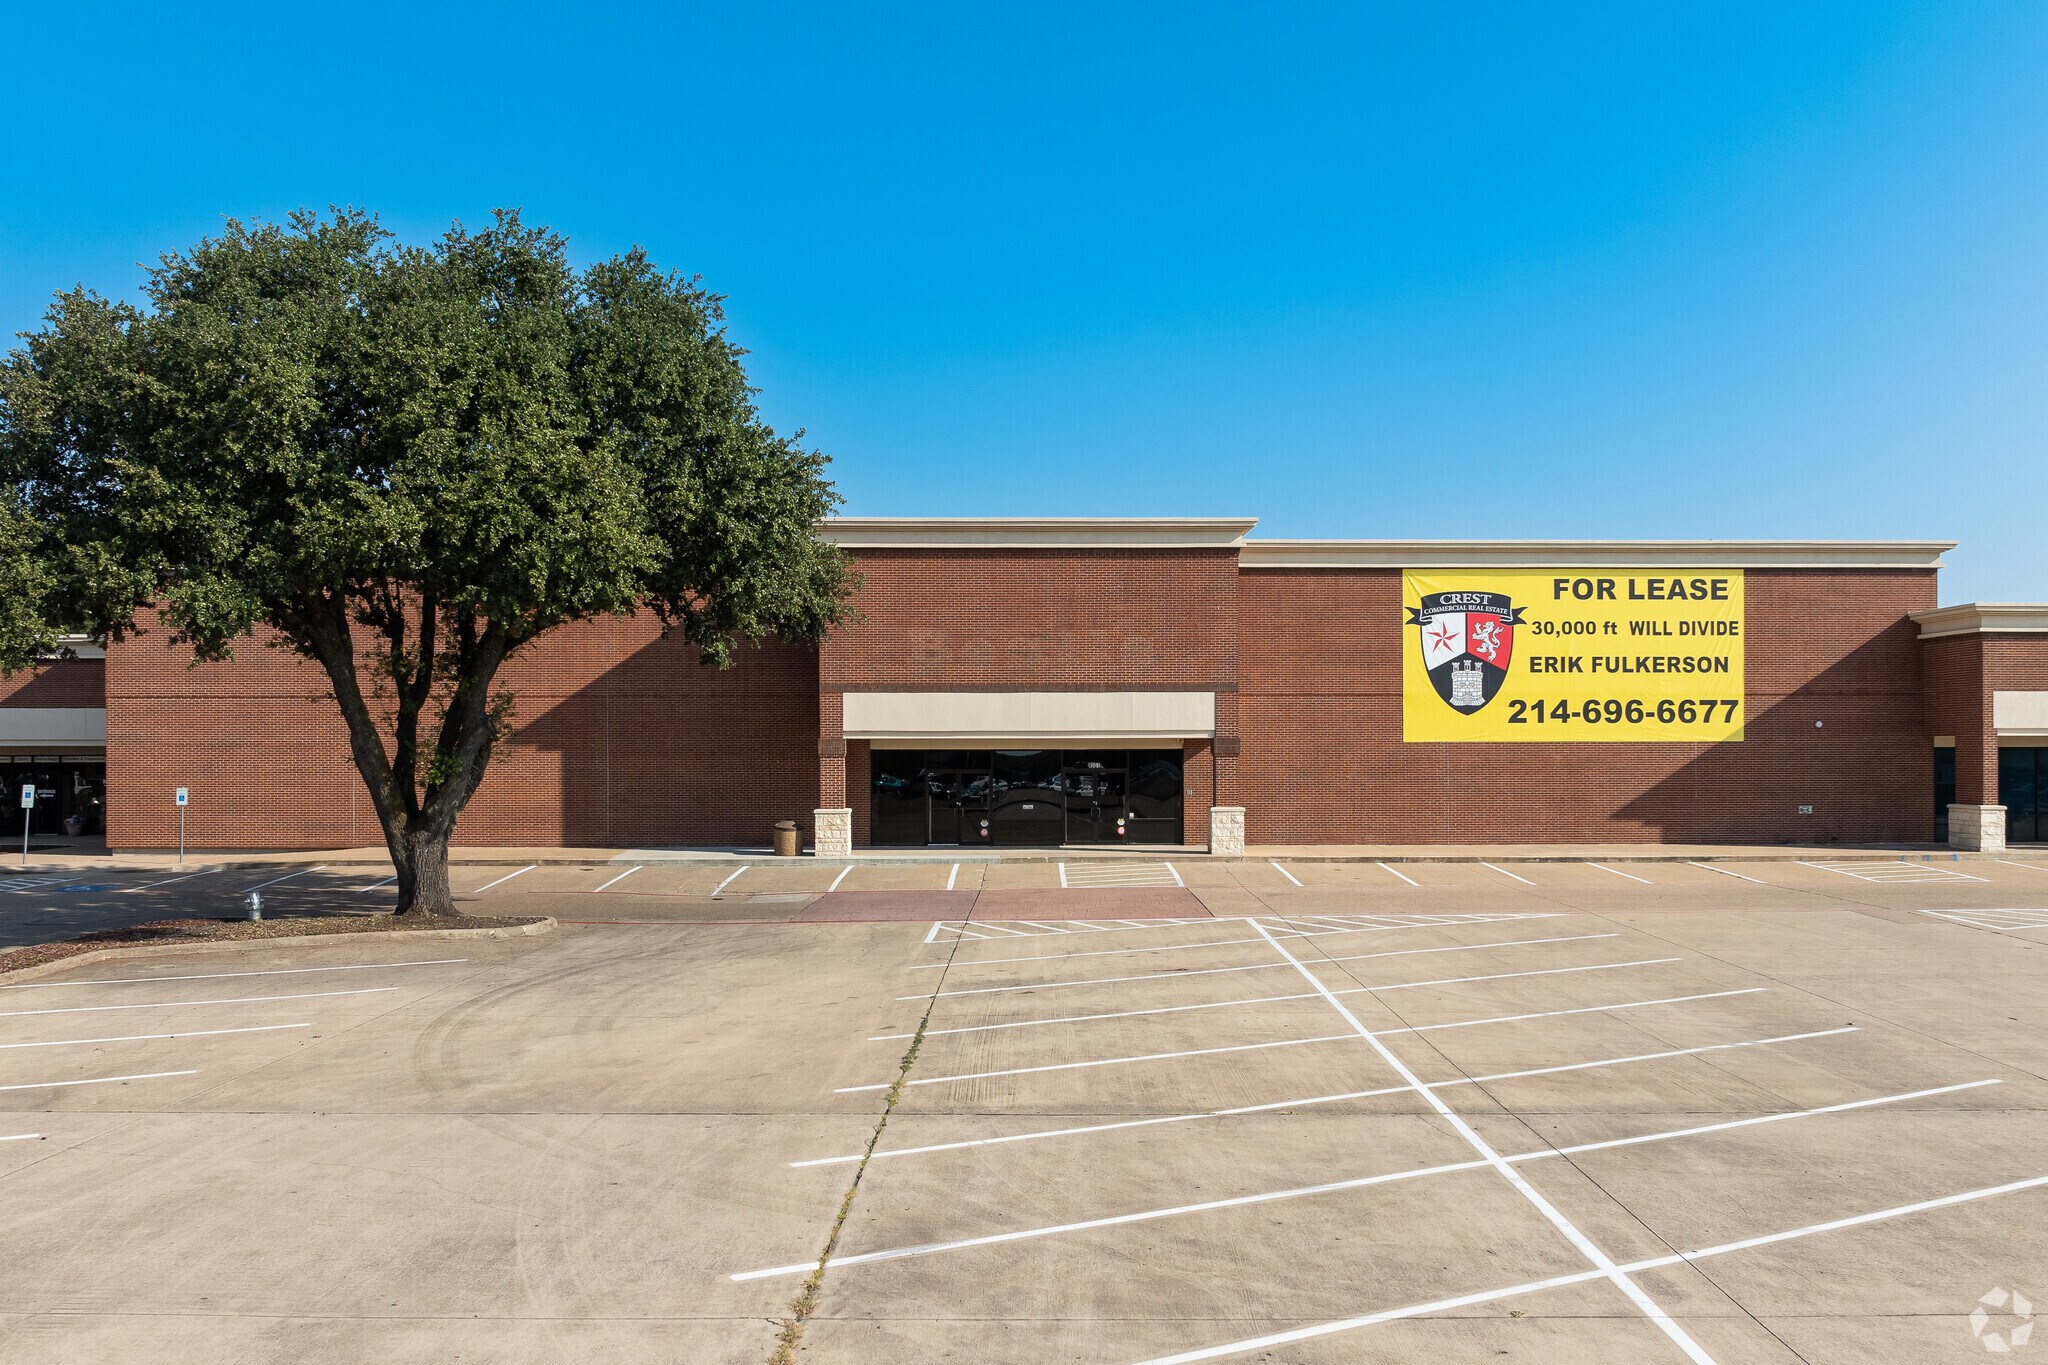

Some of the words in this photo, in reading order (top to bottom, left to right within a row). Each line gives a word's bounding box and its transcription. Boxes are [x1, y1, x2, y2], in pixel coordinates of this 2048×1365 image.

[1554, 579, 1616, 600] FOR
[1629, 579, 1728, 600] LEASE
[1439, 593, 1492, 605] CREST
[1424, 605, 1467, 615] COMMERCIAL
[1485, 606, 1508, 614] ESTATE
[1532, 621, 1596, 637] 30,000
[1603, 621, 1617, 634] ft
[1630, 621, 1672, 635] WILL
[1680, 621, 1738, 635] DIVIDE
[1530, 657, 1583, 672] ERIK
[1592, 657, 1728, 673] FULKERSON
[1508, 700, 1738, 723] 214-696-6677
